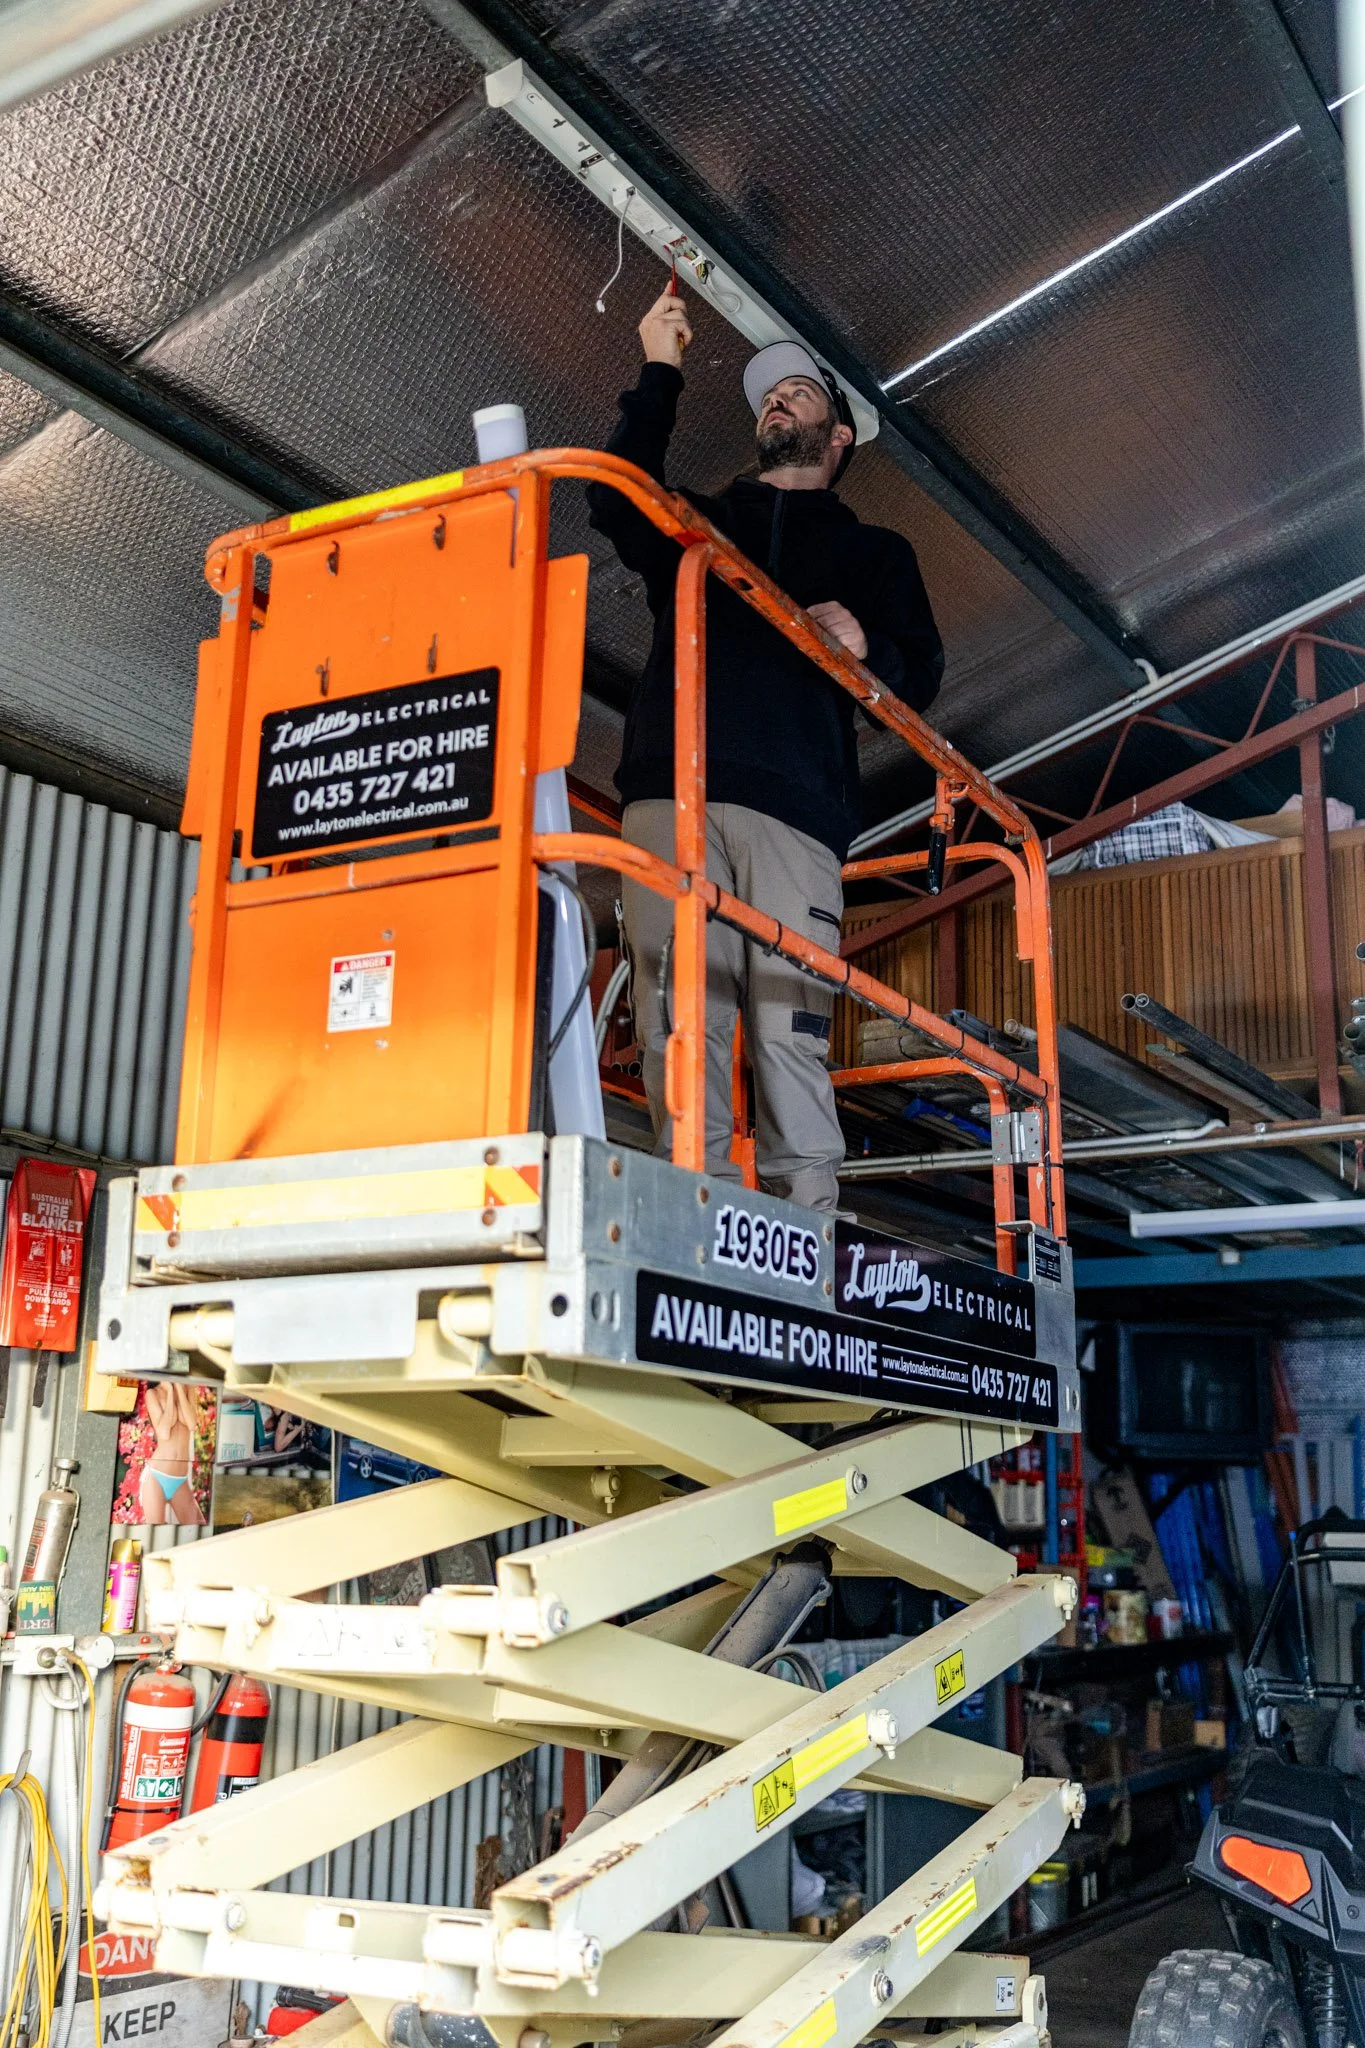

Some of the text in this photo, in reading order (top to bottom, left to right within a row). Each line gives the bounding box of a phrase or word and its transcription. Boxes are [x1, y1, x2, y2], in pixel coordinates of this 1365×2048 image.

[271, 689, 491, 755] Layton ELECTRICAL
[267, 725, 490, 788] AVAILABLE FOR HIRE
[293, 762, 456, 815] 0435 727 421
[278, 796, 468, 840] www.laytonelectrical.com.au
[349, 957, 387, 970] DANGER
[21, 1212, 84, 1234] BLANKET
[37, 1202, 70, 1219] FIRE
[713, 1204, 820, 1286] 1930ES
[843, 1242, 1032, 1332] Layton ELECTRICAL
[650, 1293, 1052, 1408] AVAILABLE FOR HIRE www.laytonelectrical.com.au 0435 727 421
[103, 2000, 176, 2045] KEEP
